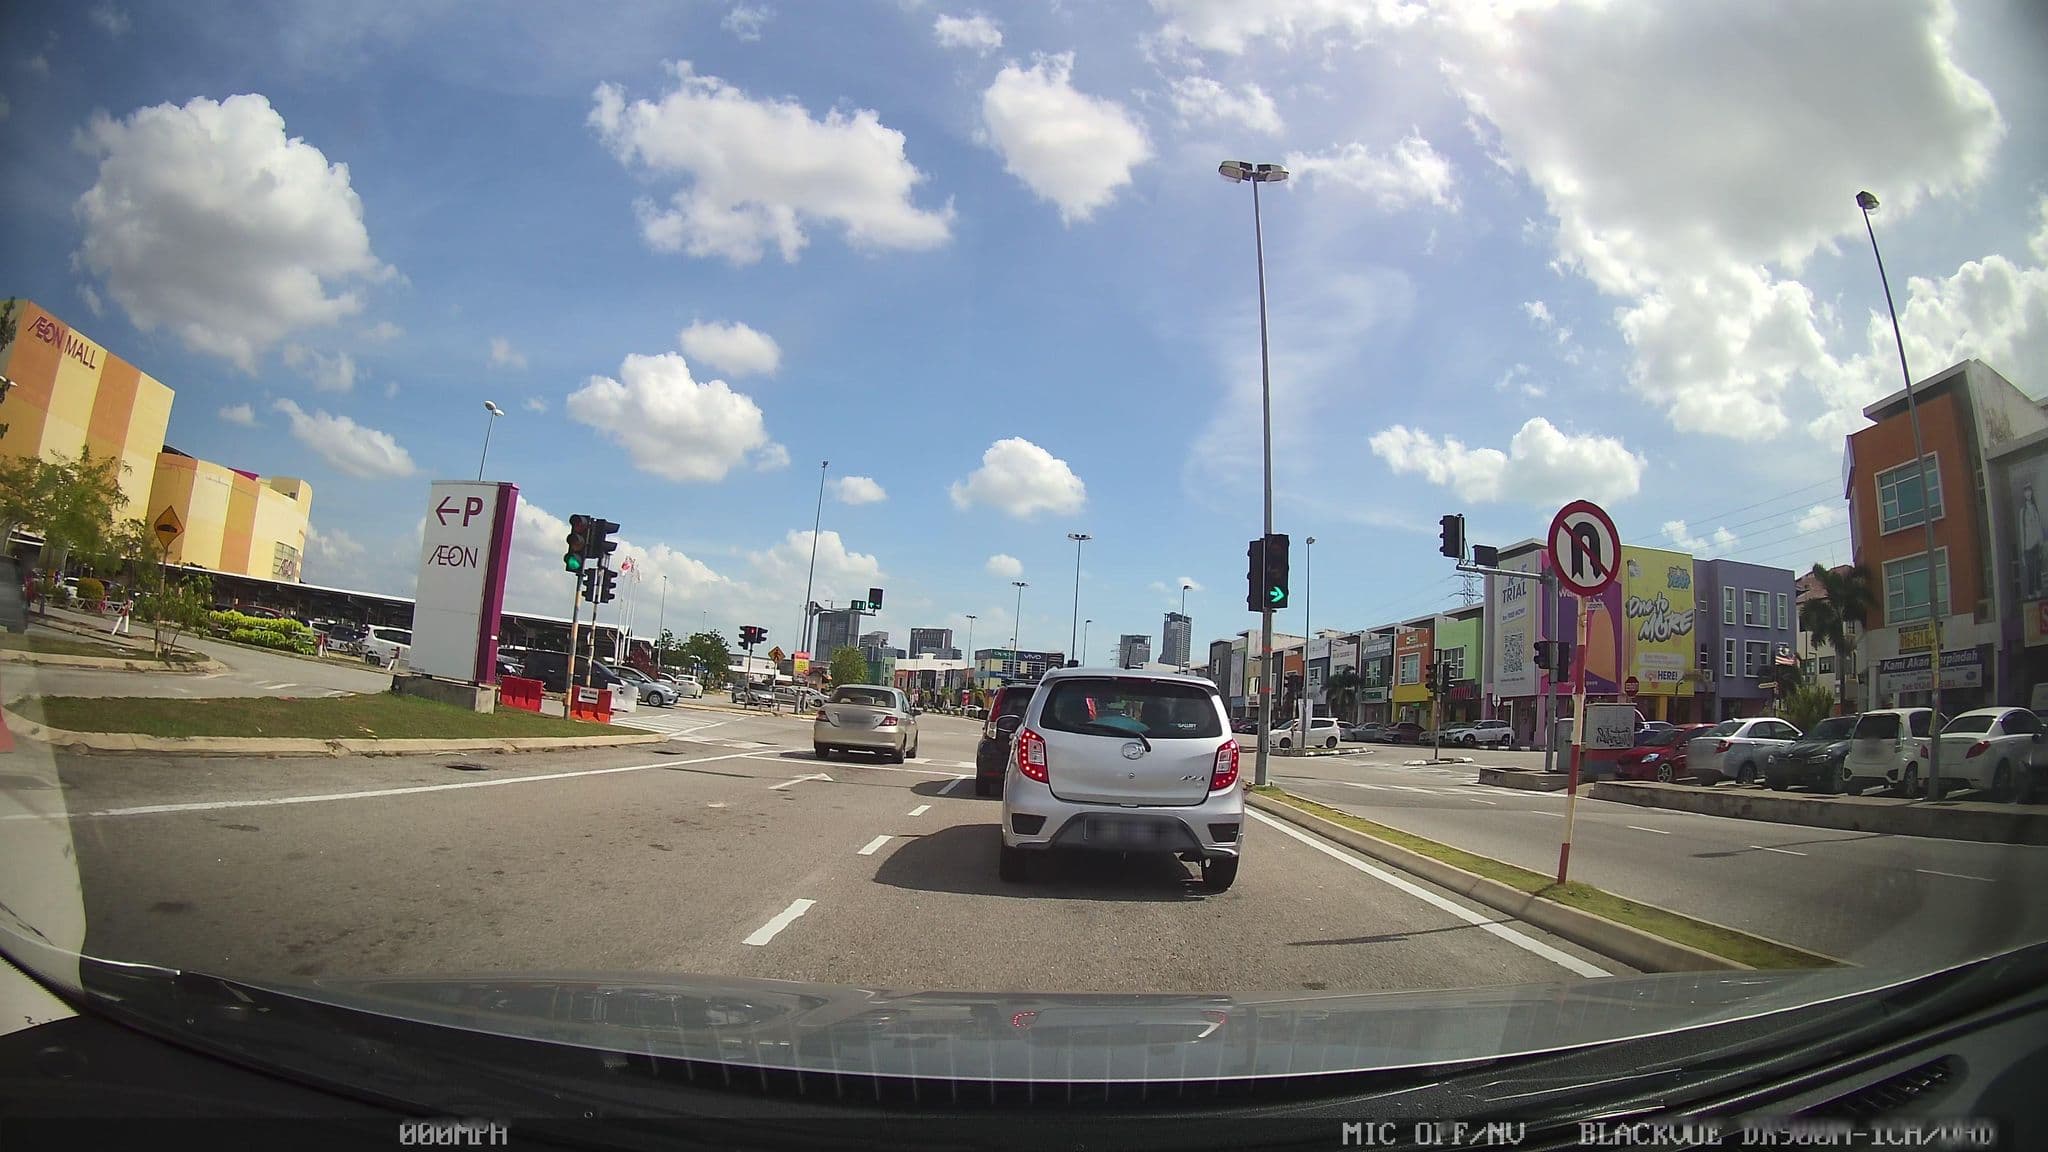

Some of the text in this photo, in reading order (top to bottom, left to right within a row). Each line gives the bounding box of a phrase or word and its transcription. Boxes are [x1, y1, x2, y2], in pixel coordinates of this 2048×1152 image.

[64, 335, 96, 370] MALL
[462, 496, 484, 527] P
[1502, 581, 1527, 603] TRIAL
[1638, 608, 1694, 643] MORE
[1657, 670, 1678, 681] HERE!
[1883, 660, 1905, 671] Kami
[1906, 657, 1930, 669] Akan
